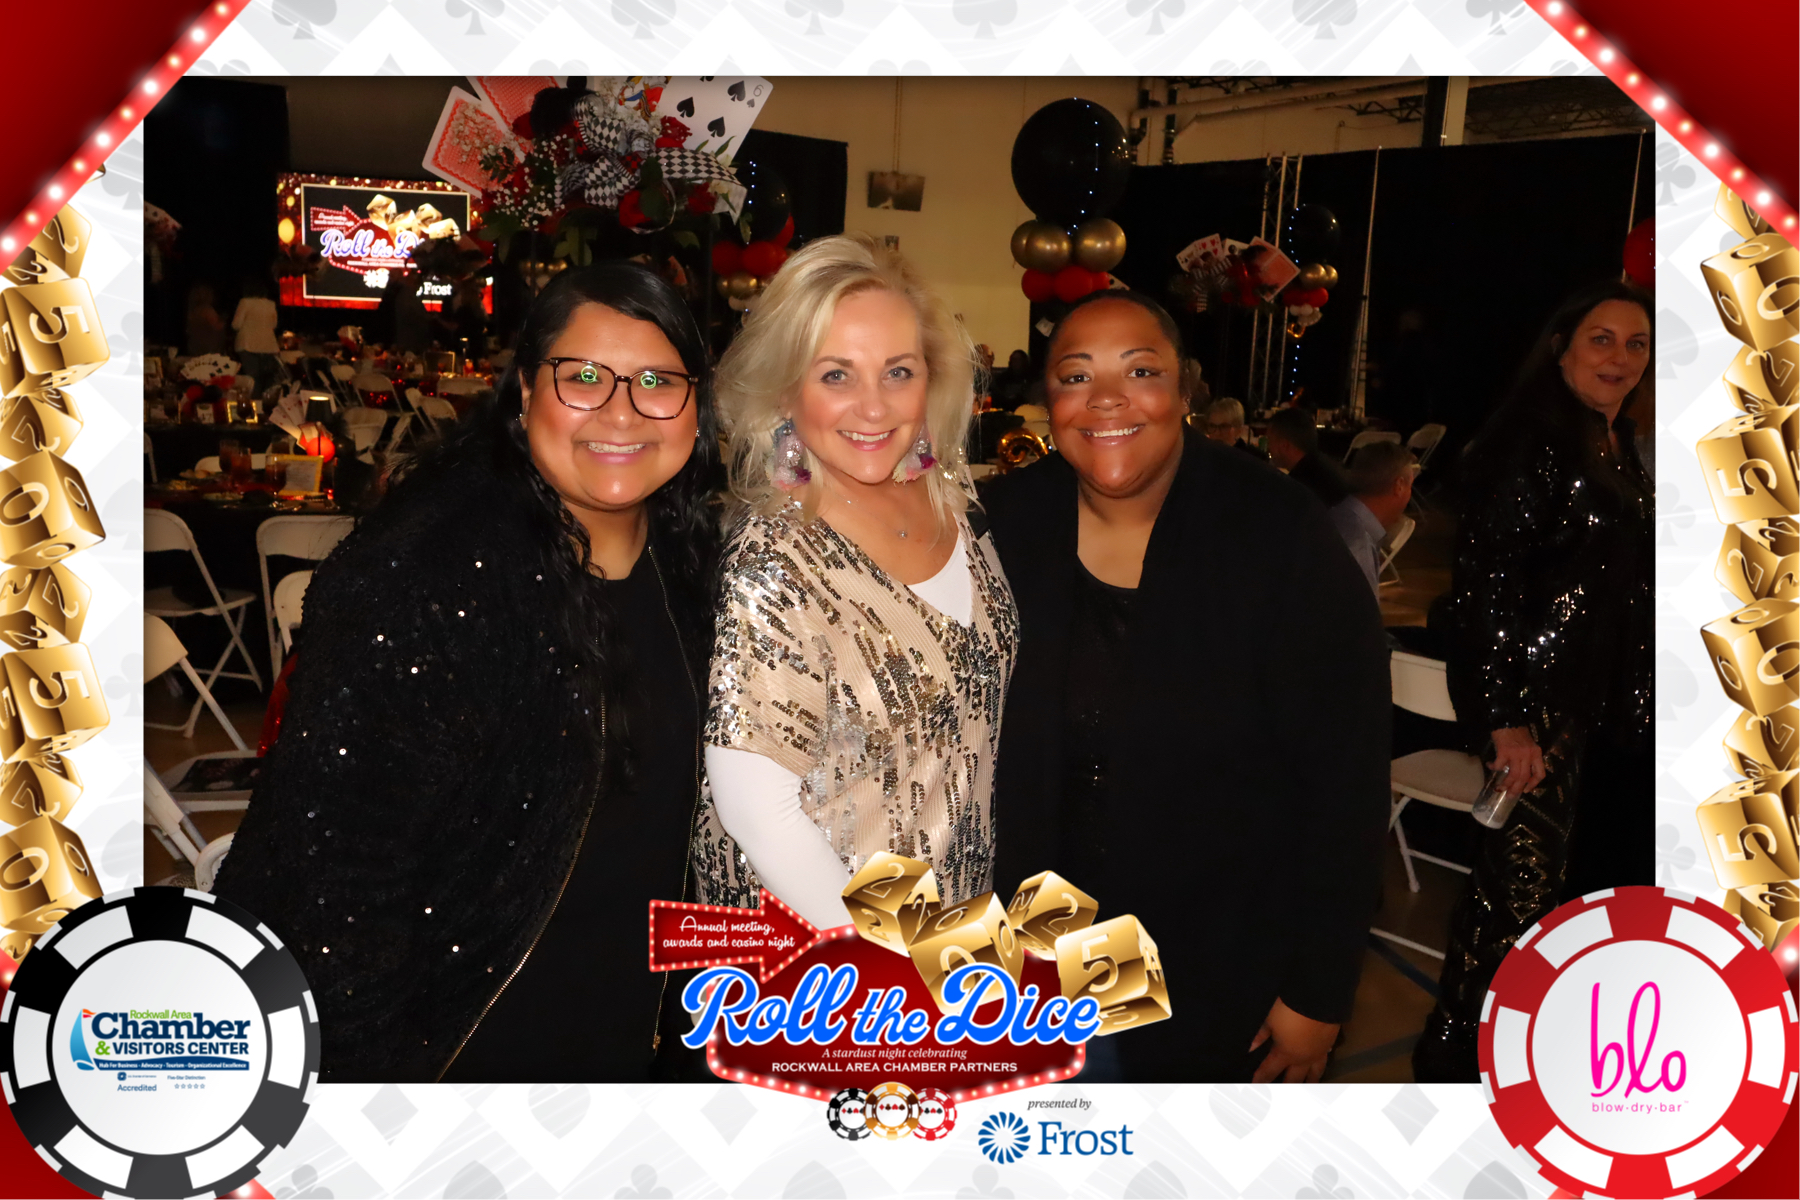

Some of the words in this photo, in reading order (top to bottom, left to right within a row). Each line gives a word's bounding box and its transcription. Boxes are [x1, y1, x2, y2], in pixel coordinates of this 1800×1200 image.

[753, 84, 764, 97] 6
[320, 229, 375, 257] Roll
[370, 238, 394, 256] the
[423, 281, 452, 296] Frost
